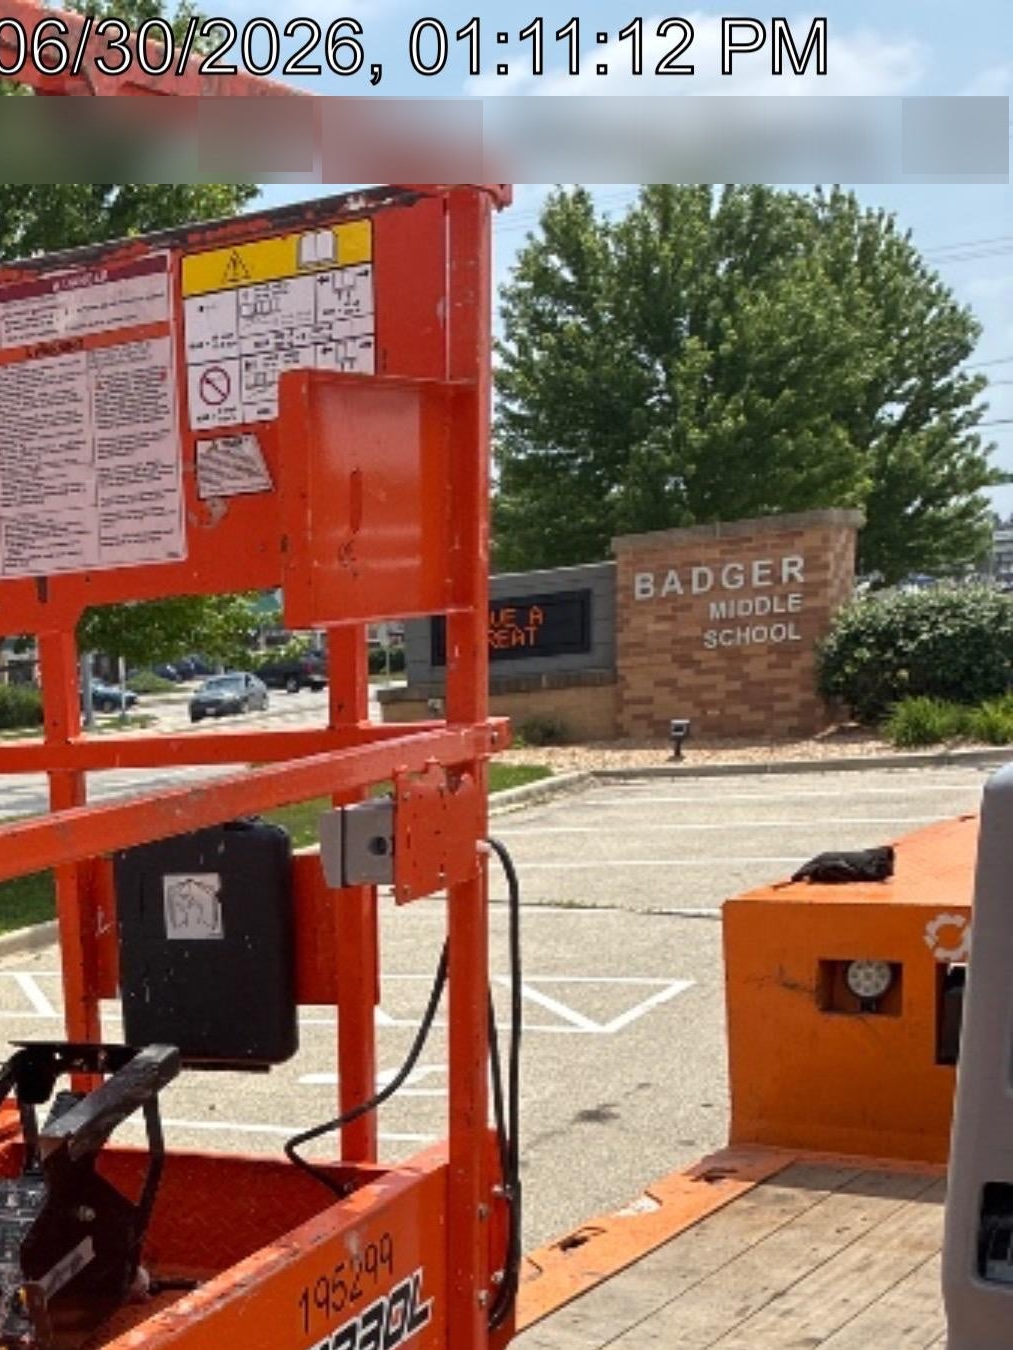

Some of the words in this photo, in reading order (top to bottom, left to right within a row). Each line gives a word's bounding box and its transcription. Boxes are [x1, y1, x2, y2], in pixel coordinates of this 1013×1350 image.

[633, 556, 806, 600] BADGER
[529, 605, 544, 626] A
[709, 594, 803, 619] MIDDLE
[487, 625, 539, 649] REAT
[703, 623, 802, 649] SCHOOL
[298, 1232, 394, 1334] 195299
